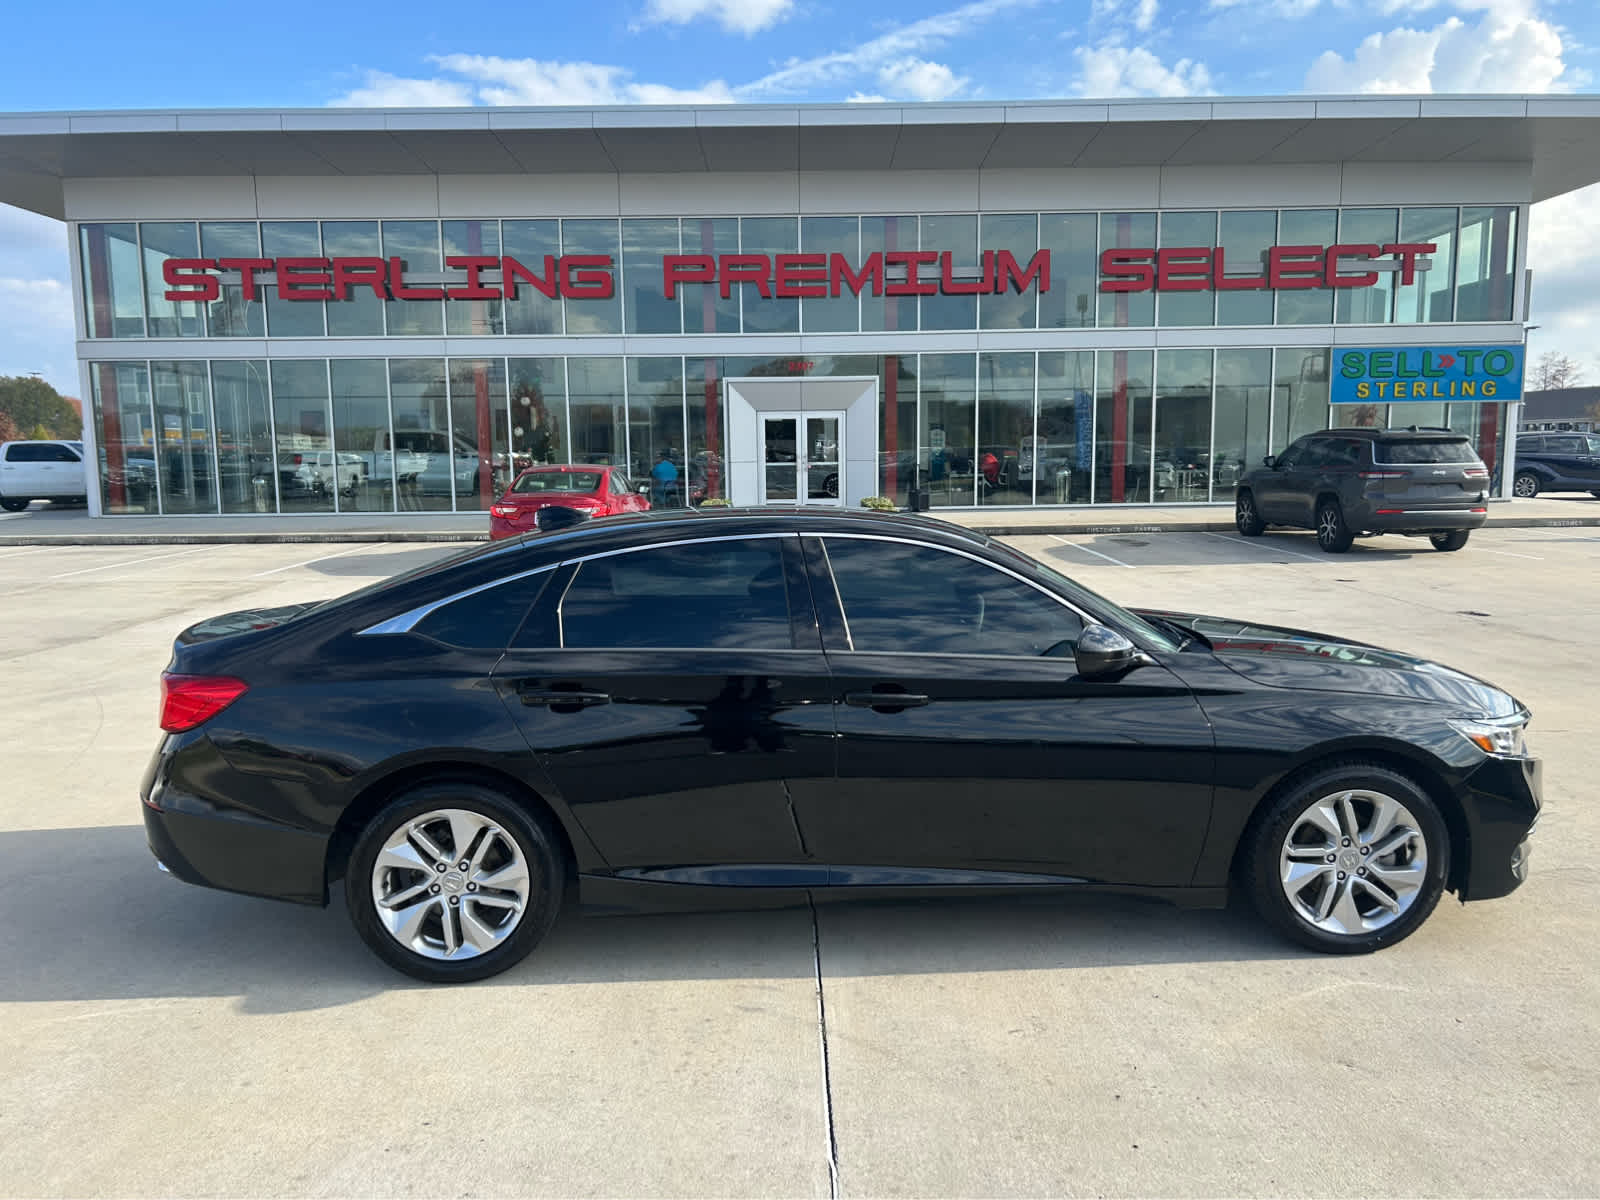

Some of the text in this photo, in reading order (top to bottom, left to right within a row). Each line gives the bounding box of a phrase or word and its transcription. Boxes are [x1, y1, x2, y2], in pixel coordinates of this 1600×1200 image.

[163, 243, 1437, 301] STERLING PREMIUM SELECT
[1341, 349, 1515, 378] SELL TO
[1356, 380, 1498, 399] STERLING
